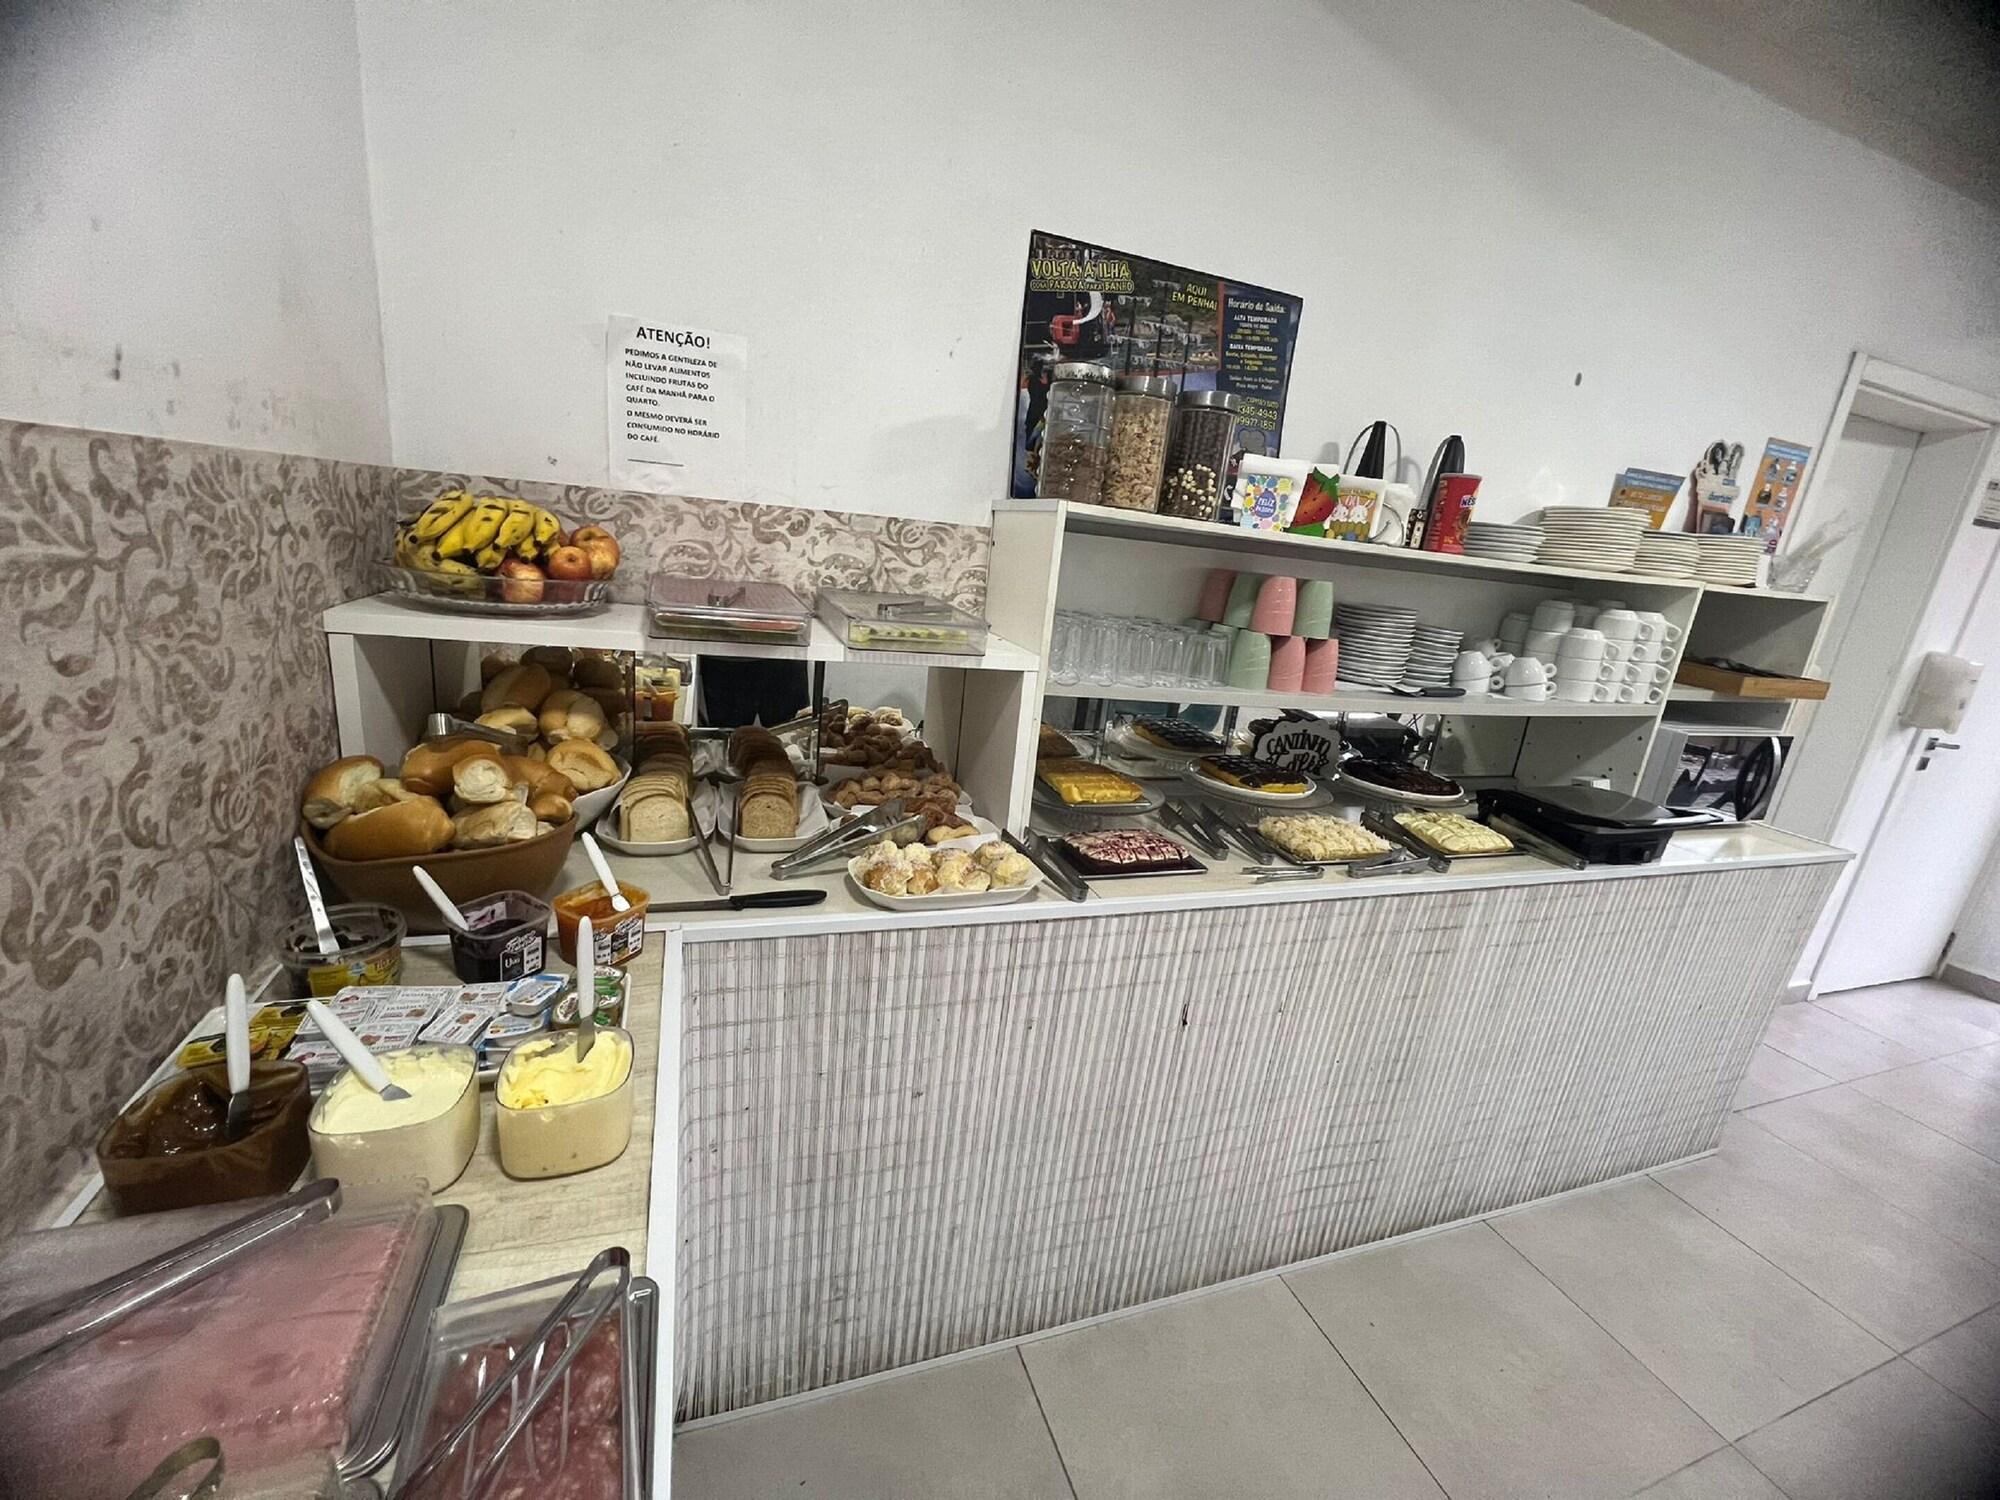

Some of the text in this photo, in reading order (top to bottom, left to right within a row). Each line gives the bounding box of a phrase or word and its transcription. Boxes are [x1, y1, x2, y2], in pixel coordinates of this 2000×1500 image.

[1031, 259, 1080, 278] VOLTA
[1099, 262, 1130, 279] ILHA
[1105, 281, 1133, 292] BANHO
[1186, 283, 1207, 296] AQUI
[1172, 291, 1185, 303] EM
[636, 326, 711, 349] ATENÇÃO!
[625, 348, 717, 368] PEDIMOS A GENTILEZA DE
[625, 360, 711, 379] NÃO LEVAR ALIMENTOS
[625, 372, 709, 390] INCLUINDO FRUTAS DO
[626, 384, 644, 393] CAFÉ
[646, 386, 657, 395] DA
[658, 388, 687, 398] MANHÃ
[688, 392, 708, 402] PARA
[634, 410, 664, 421] MESMO
[665, 414, 693, 424] DEVERÁ
[694, 418, 708, 426] SER
[627, 421, 720, 439] CONSUMIDO NO HORÁRIO
[1266, 729, 1332, 755] CANTINHO
